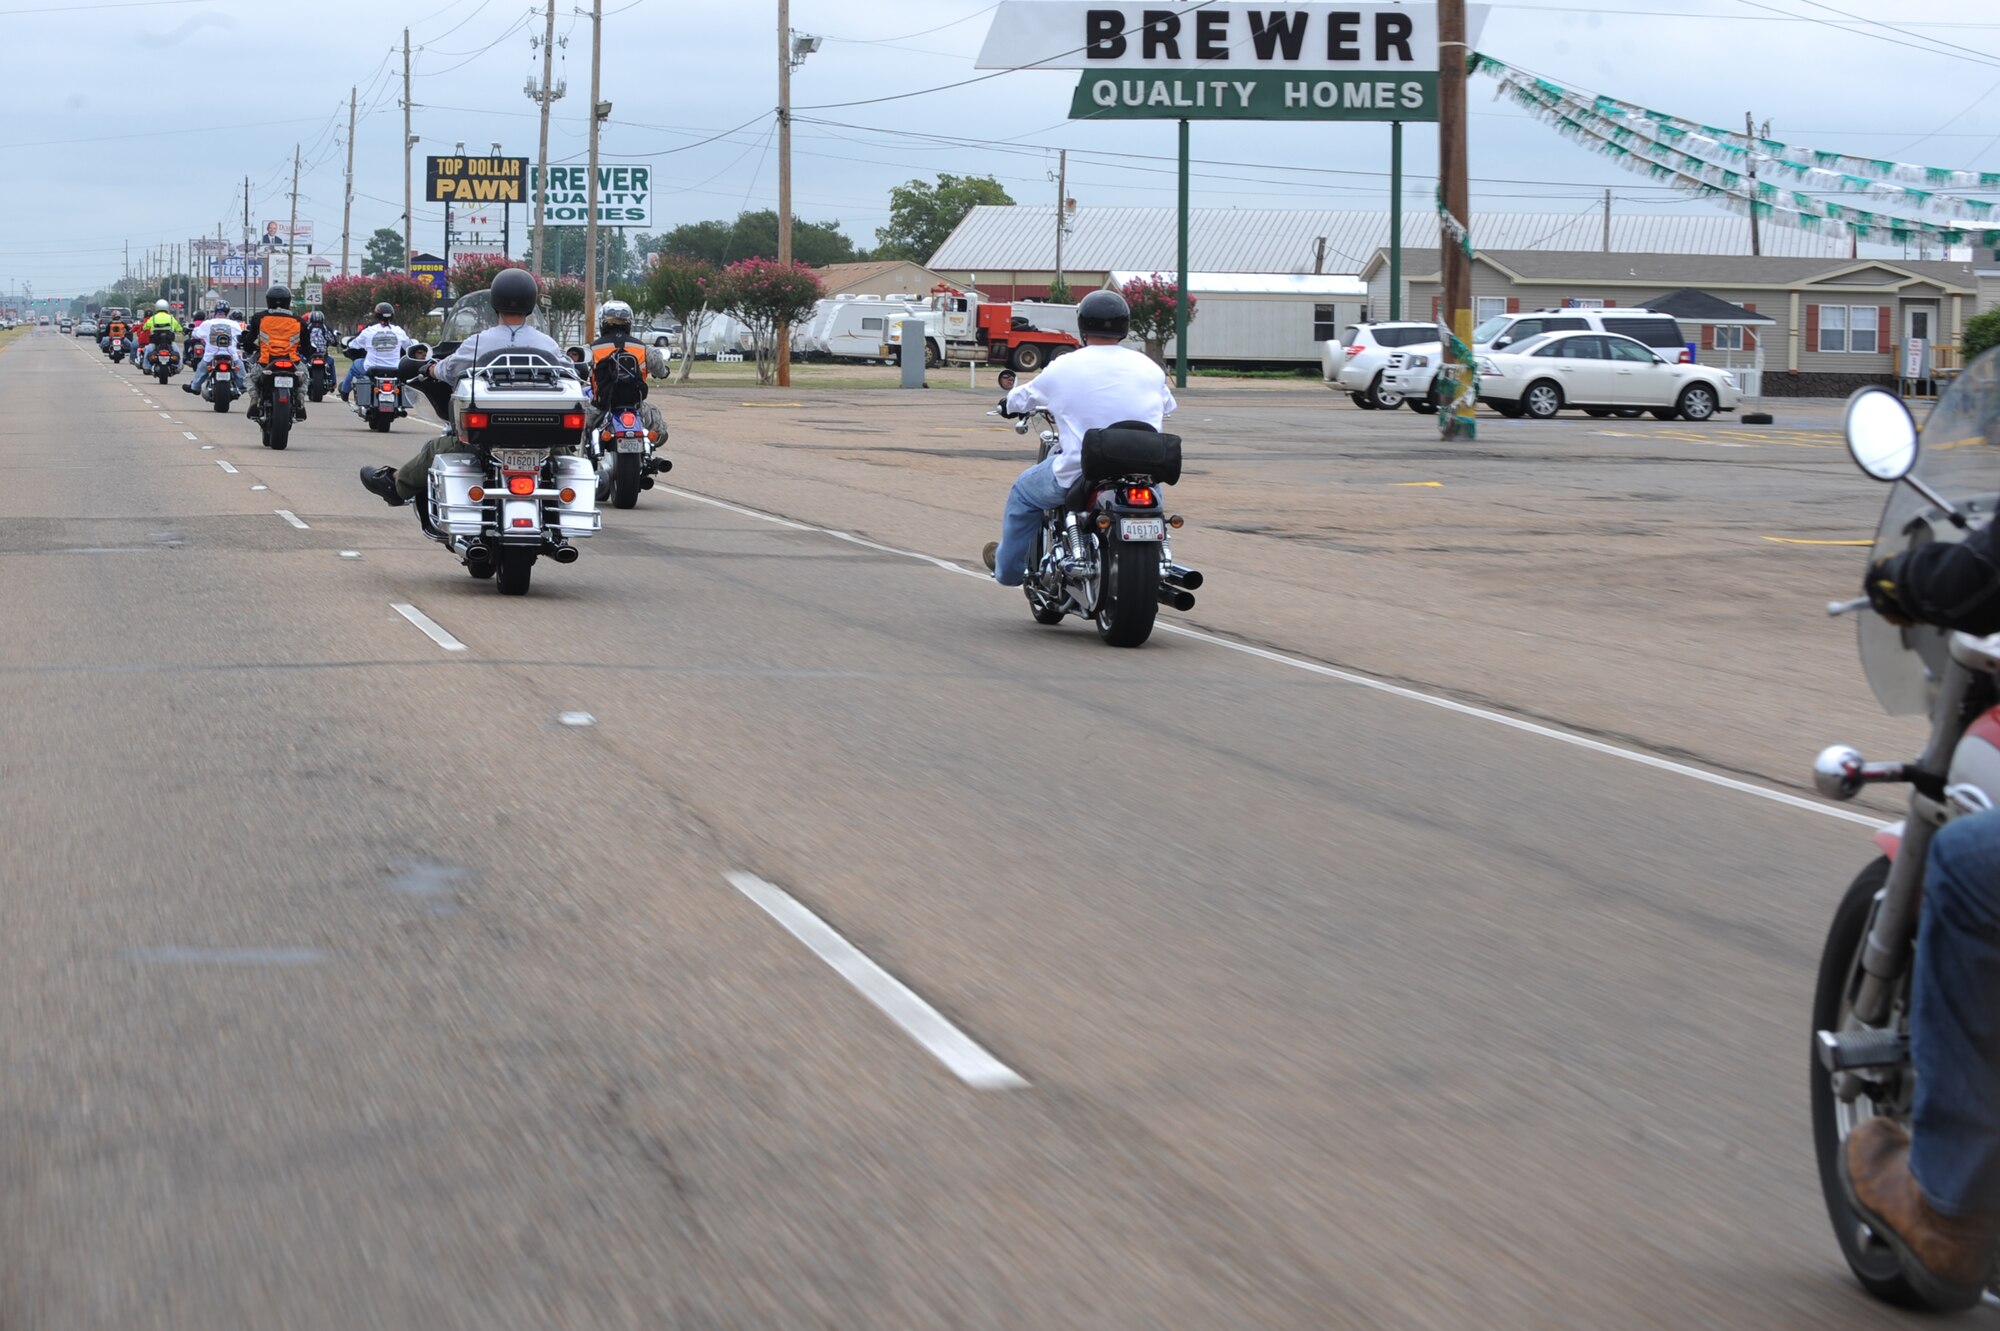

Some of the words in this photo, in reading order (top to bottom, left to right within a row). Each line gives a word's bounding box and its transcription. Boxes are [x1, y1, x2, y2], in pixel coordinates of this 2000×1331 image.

[1086, 9, 1414, 61] BREWER
[1092, 79, 1257, 108] QUALITY
[1284, 81, 1424, 109] HOMES
[436, 158, 462, 176] TOP
[468, 159, 520, 177] DOLLAR
[435, 178, 519, 201] PAWN
[306, 294, 321, 303] 45
[506, 456, 536, 466] 416201
[1126, 525, 1159, 535] 416170
